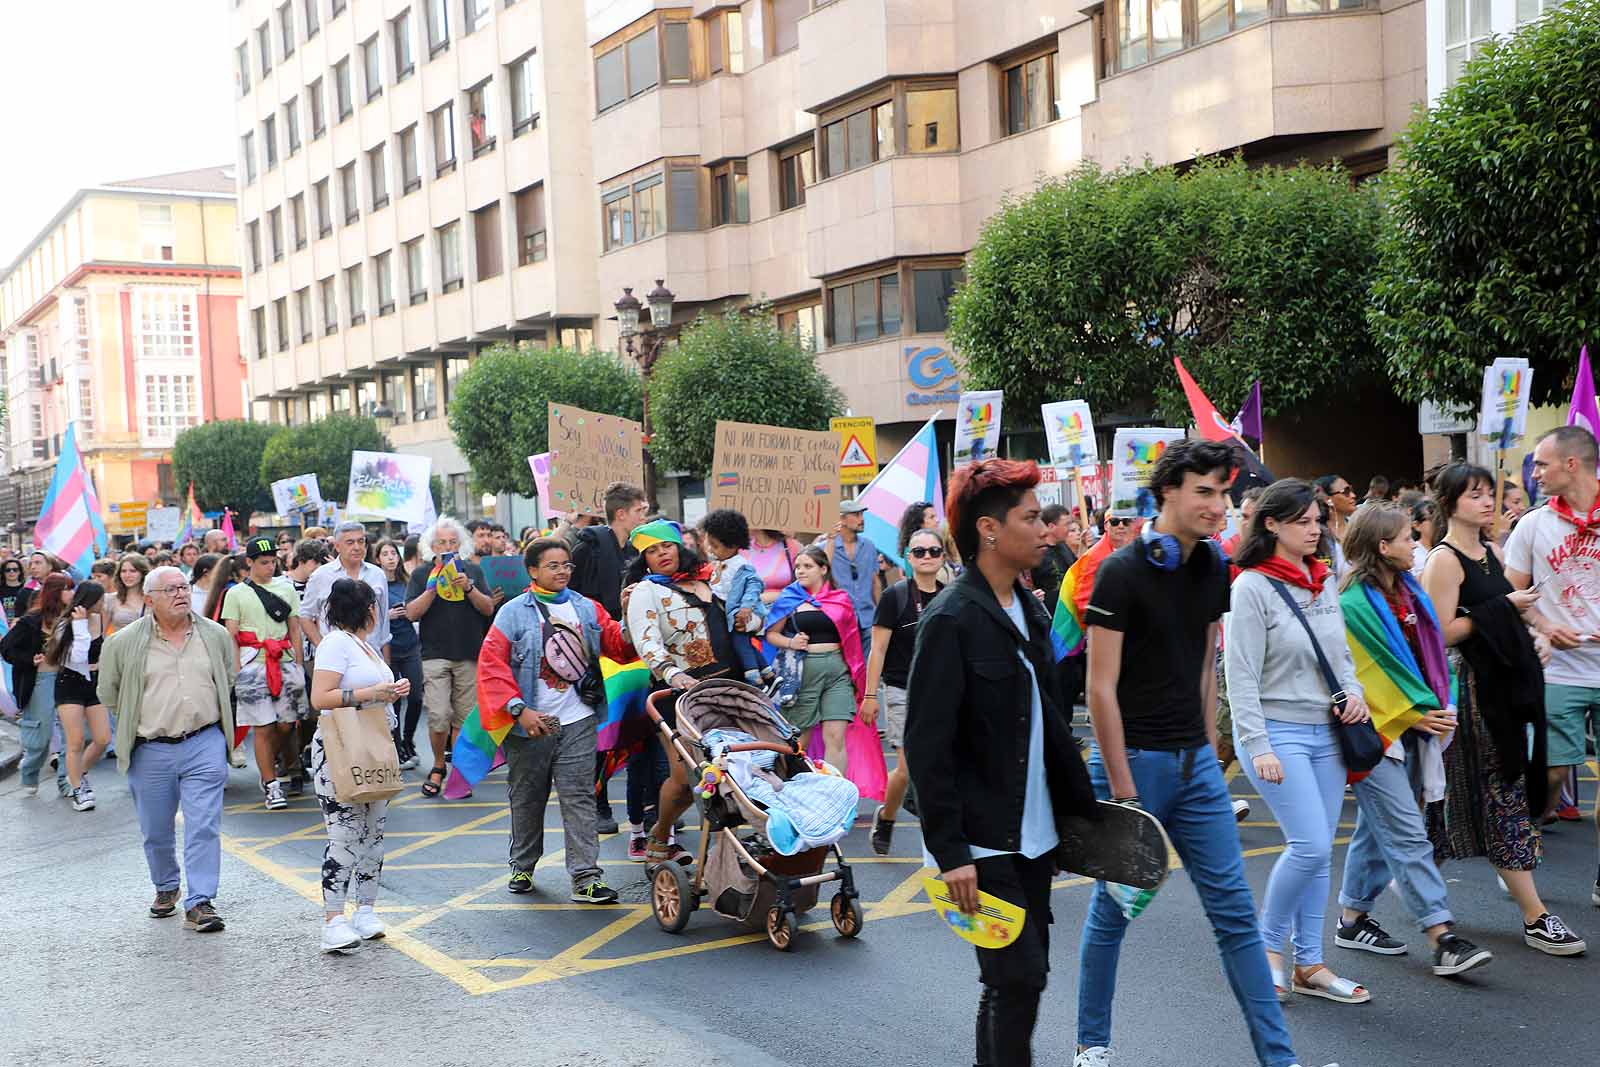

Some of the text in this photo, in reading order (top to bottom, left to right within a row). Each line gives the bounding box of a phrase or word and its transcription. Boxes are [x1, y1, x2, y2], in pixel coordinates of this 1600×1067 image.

[559, 415, 581, 449] Soy
[724, 431, 736, 448] NI
[742, 431, 754, 448] MI
[759, 432, 791, 450] FORMA
[793, 434, 803, 452] DE
[722, 451, 731, 467] NI
[733, 452, 745, 467] MI
[750, 453, 778, 470] FORMA
[783, 455, 795, 471] DE
[738, 474, 771, 494] HACEN
